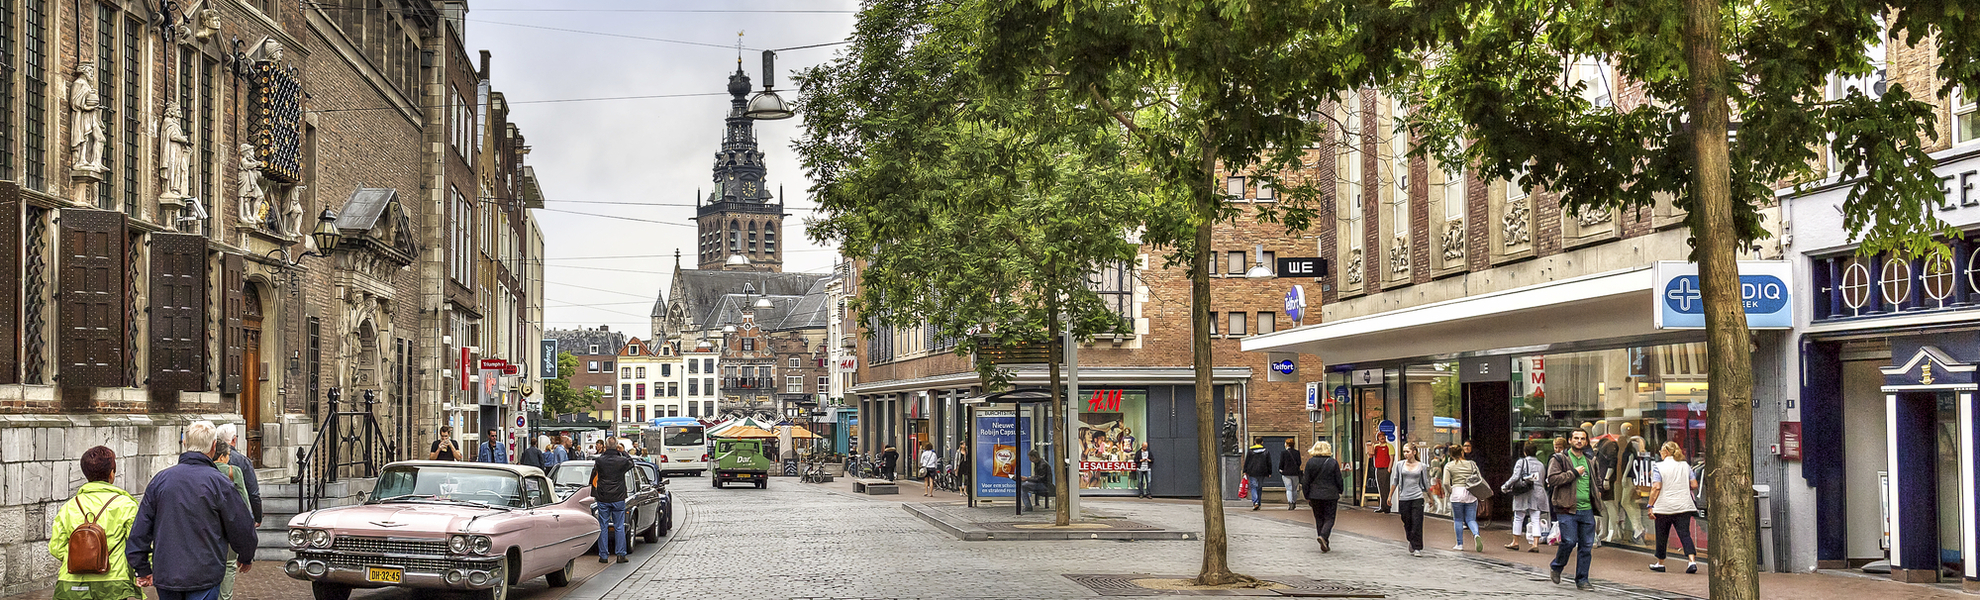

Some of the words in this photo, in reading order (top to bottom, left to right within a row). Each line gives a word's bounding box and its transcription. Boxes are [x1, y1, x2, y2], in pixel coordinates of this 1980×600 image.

[1288, 261, 1314, 273] WE
[1742, 283, 1781, 300] DIQ
[1284, 295, 1299, 311] Telfort
[1272, 362, 1294, 371] Telfort
[1087, 389, 1123, 412] H&M
[980, 429, 999, 437] Robijn
[1090, 462, 1113, 471] SALE
[1114, 462, 1137, 471] SALE
[371, 571, 400, 581] DH-32-45
